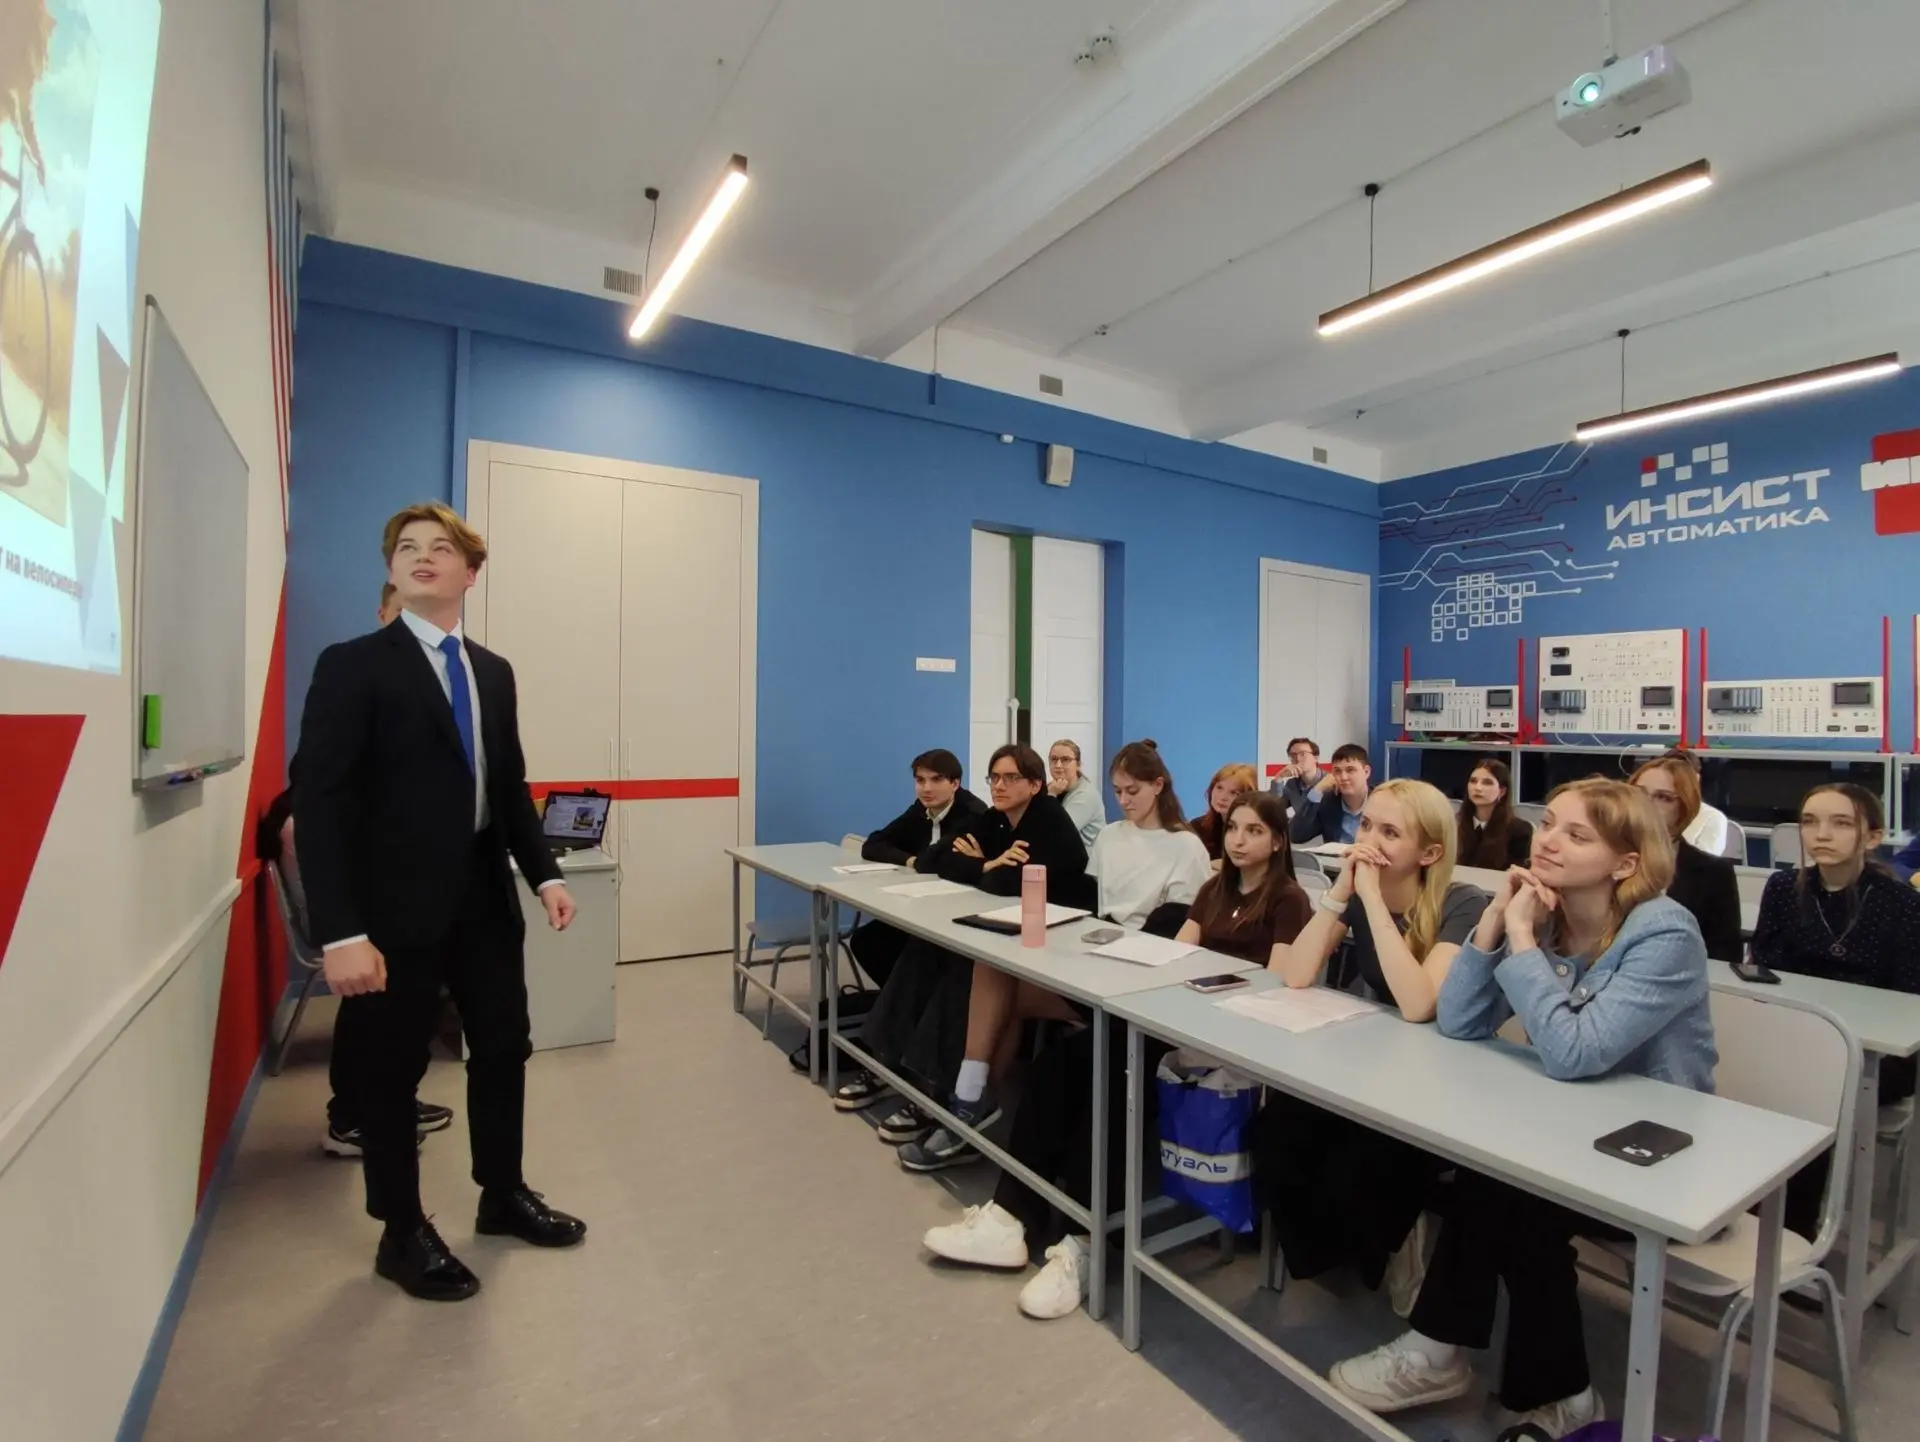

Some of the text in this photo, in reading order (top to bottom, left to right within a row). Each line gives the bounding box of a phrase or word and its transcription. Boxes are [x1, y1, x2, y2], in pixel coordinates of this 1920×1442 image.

[1606, 469, 1830, 529] ИНСИСТ
[1607, 507, 1829, 550] АВТОМАТИКА
[6, 550, 21, 575] на
